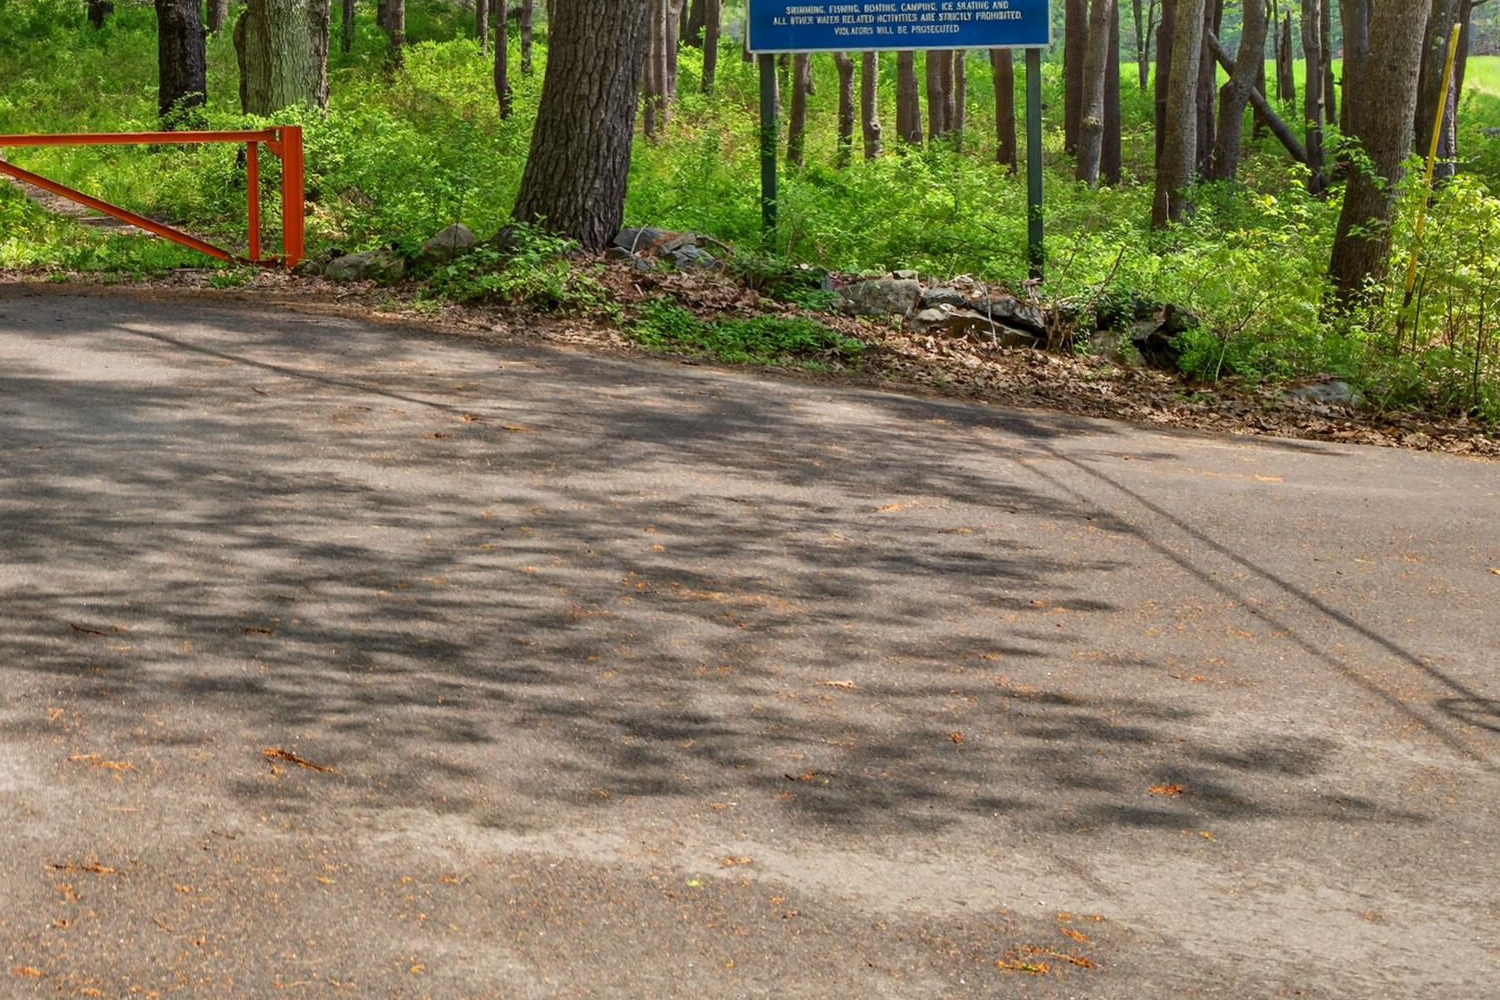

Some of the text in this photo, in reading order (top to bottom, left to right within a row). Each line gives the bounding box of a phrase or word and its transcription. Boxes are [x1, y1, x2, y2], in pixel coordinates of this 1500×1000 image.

[941, 1, 953, 11] ICE
[956, 1, 989, 10] SKATING
[992, 0, 1009, 10] AND
[773, 16, 788, 26] ALL
[816, 15, 839, 25] WATER
[842, 14, 874, 24] RELATED
[877, 13, 917, 23] ACTIVITIES
[920, 12, 935, 22] ARE
[938, 12, 972, 22] STRICTLY
[834, 26, 873, 36] VIOLATORS
[877, 25, 894, 35] WILL
[897, 25, 907, 34] BE
